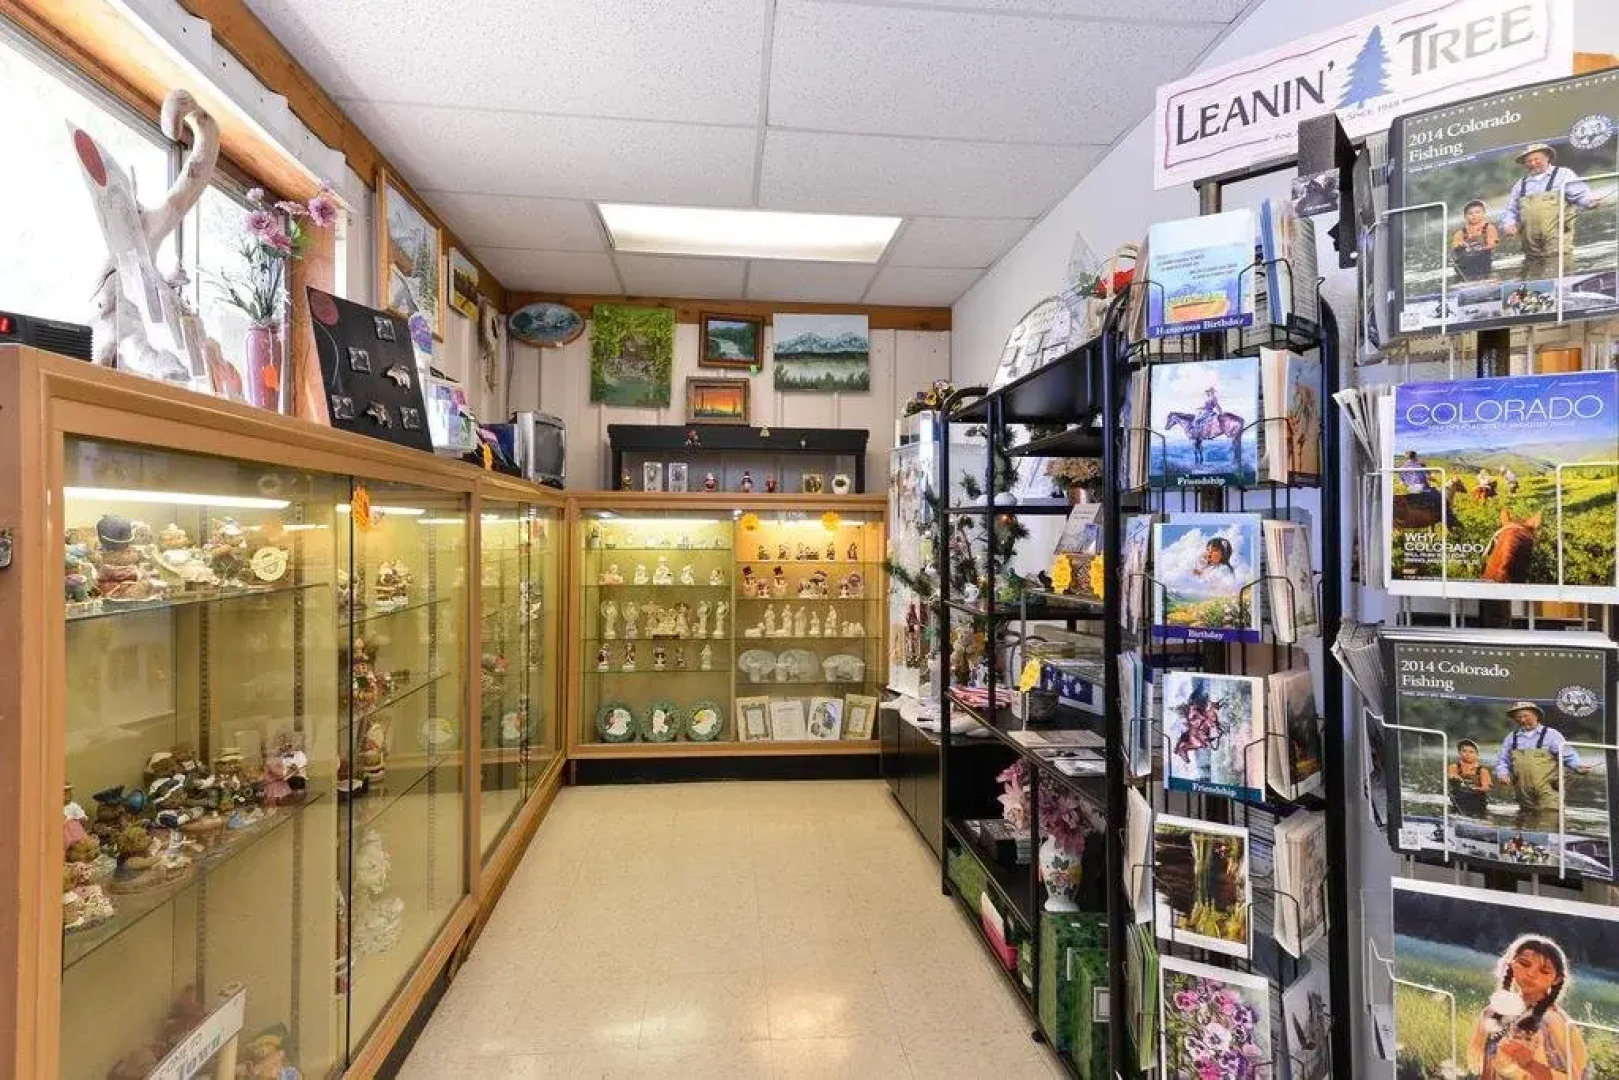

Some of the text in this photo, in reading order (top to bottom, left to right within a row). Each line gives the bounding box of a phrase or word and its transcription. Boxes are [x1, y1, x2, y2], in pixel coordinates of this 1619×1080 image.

[1176, 4, 1535, 145] LEANIN' TREE
[1408, 129, 1443, 148] 2014
[1447, 110, 1521, 138] Colorado
[1409, 141, 1464, 162] Fishing
[1406, 394, 1604, 426] COLORADO
[1177, 476, 1226, 486] Friendship
[1404, 532, 1436, 542] WHY
[1188, 629, 1225, 641] Birthday
[1401, 660, 1509, 678] 2014 Colorado
[1402, 674, 1455, 692] Fishing
[1191, 782, 1237, 798] Friendship
